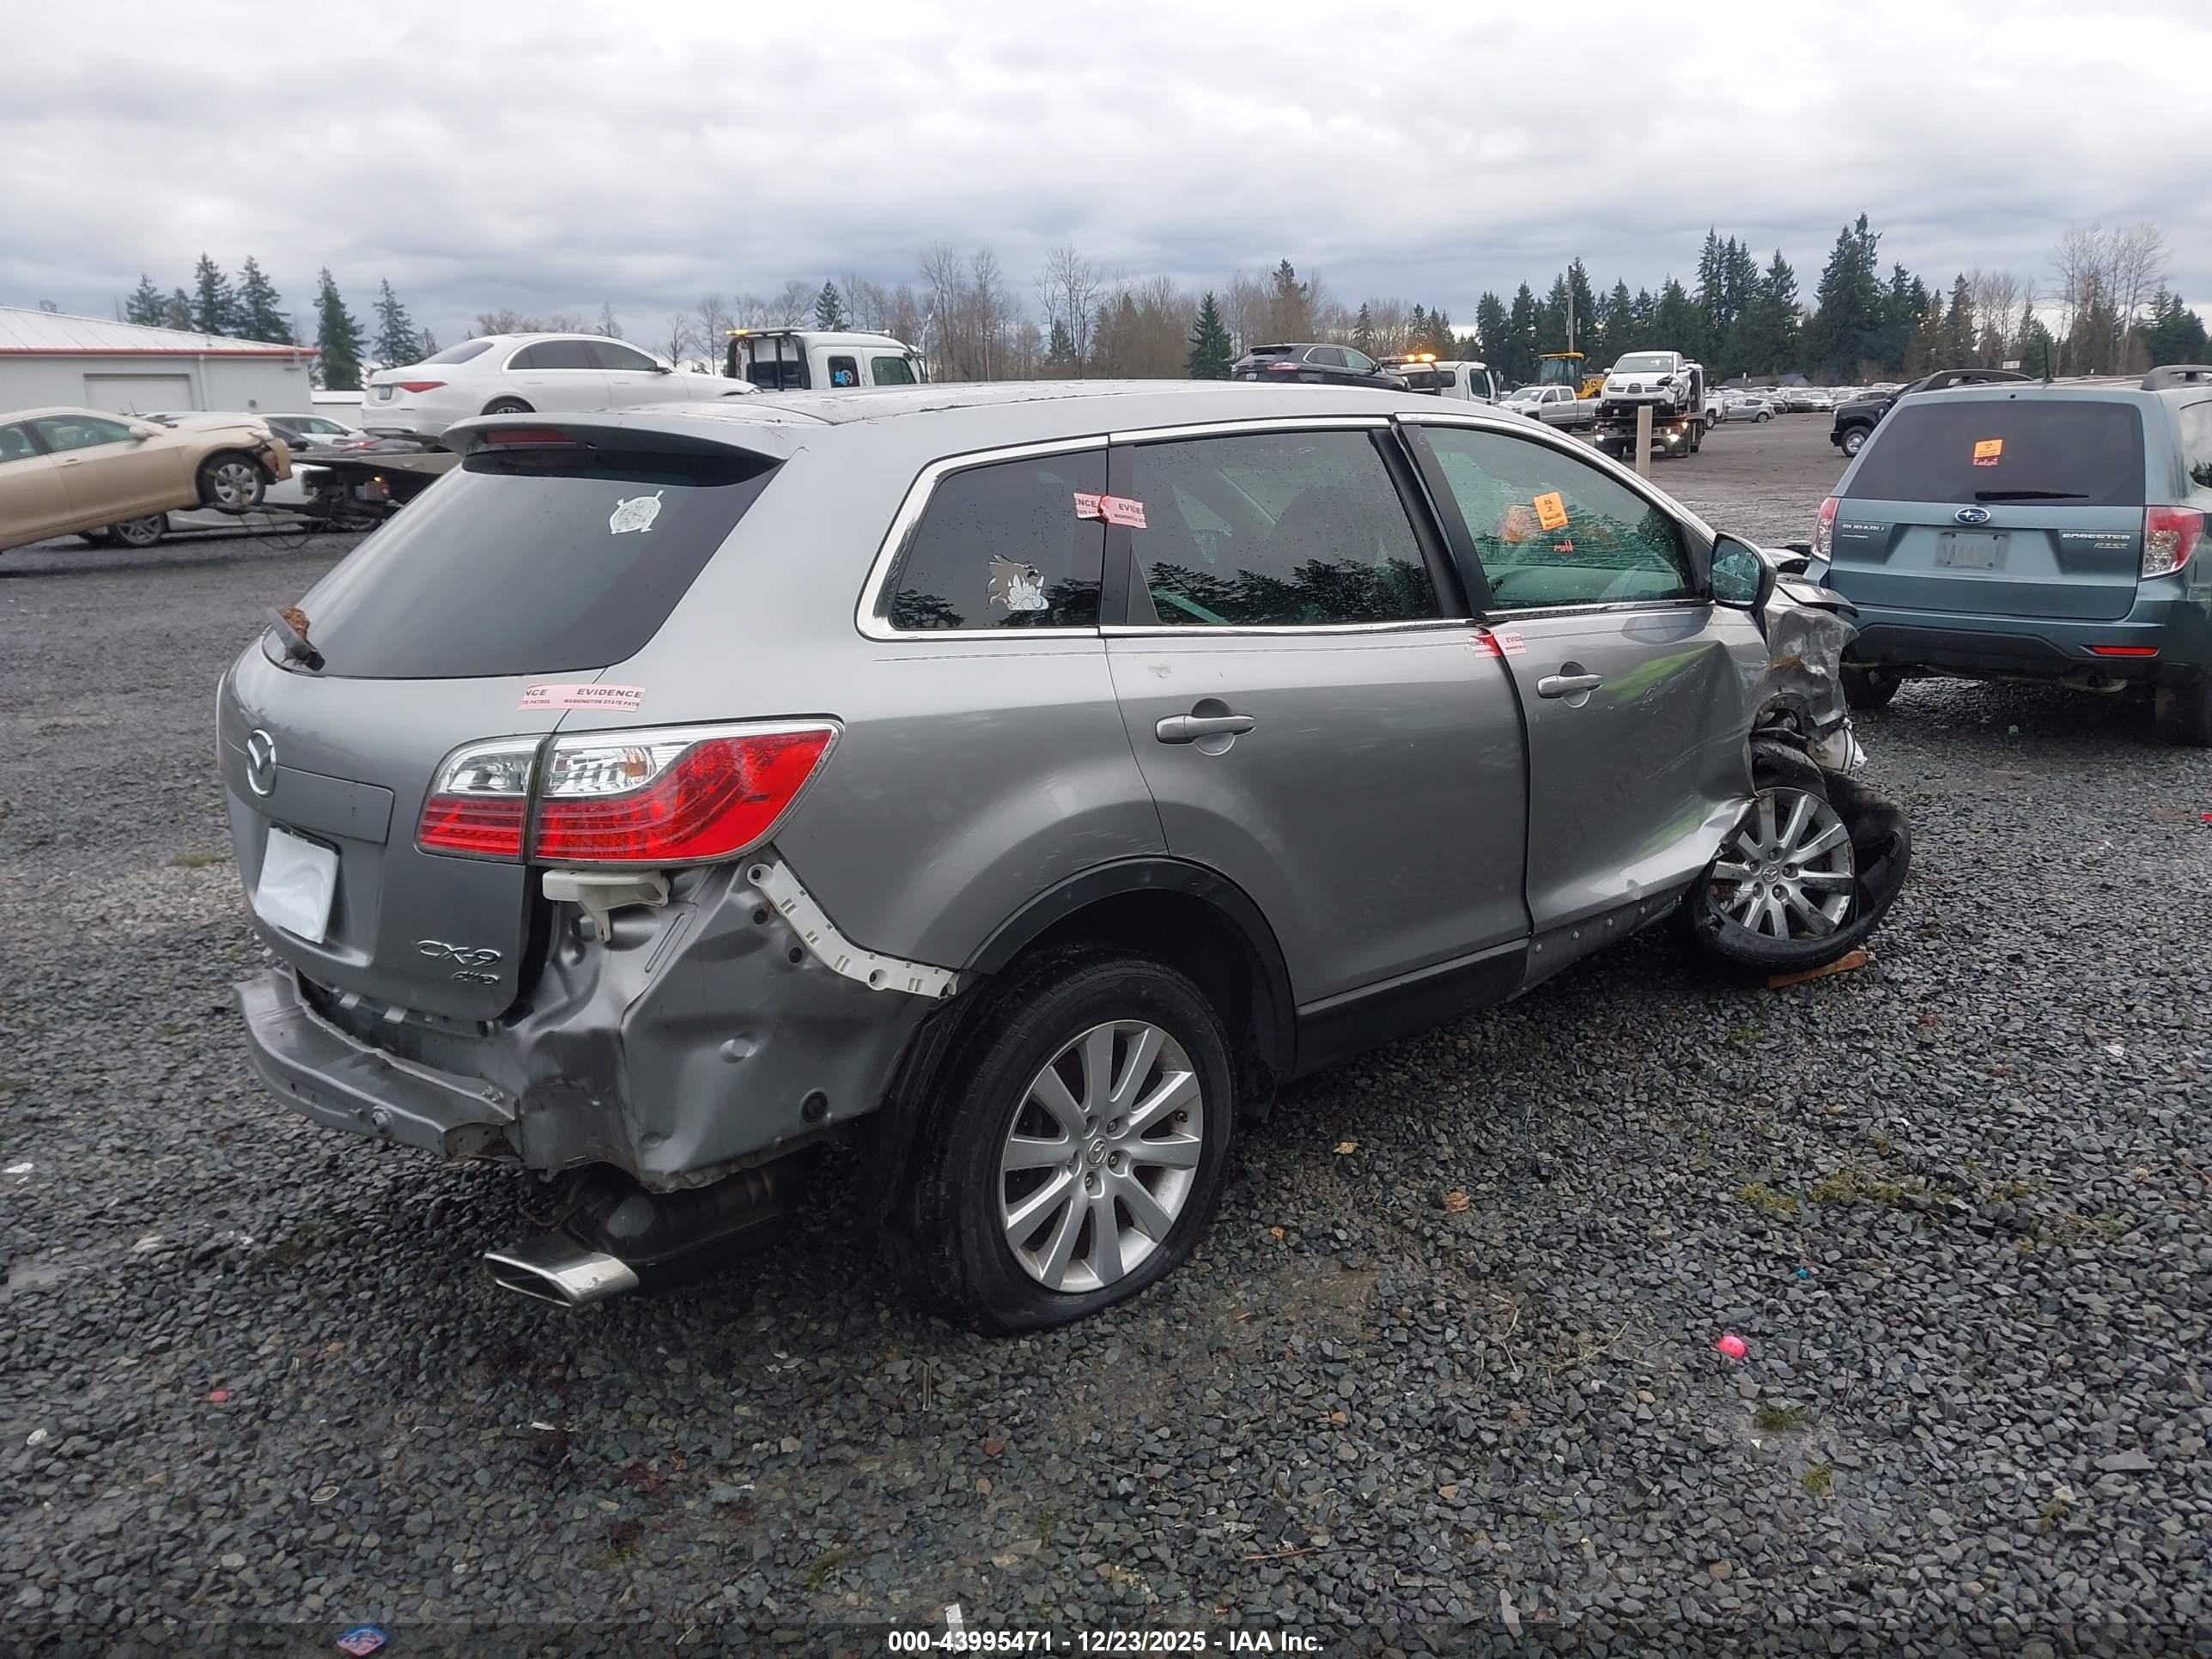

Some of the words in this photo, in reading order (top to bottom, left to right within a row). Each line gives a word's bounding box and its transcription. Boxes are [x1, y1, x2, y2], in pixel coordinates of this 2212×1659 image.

[577, 688, 644, 699] EVIDENCE
[416, 939, 502, 967] CX-9
[452, 970, 501, 985] AWD
